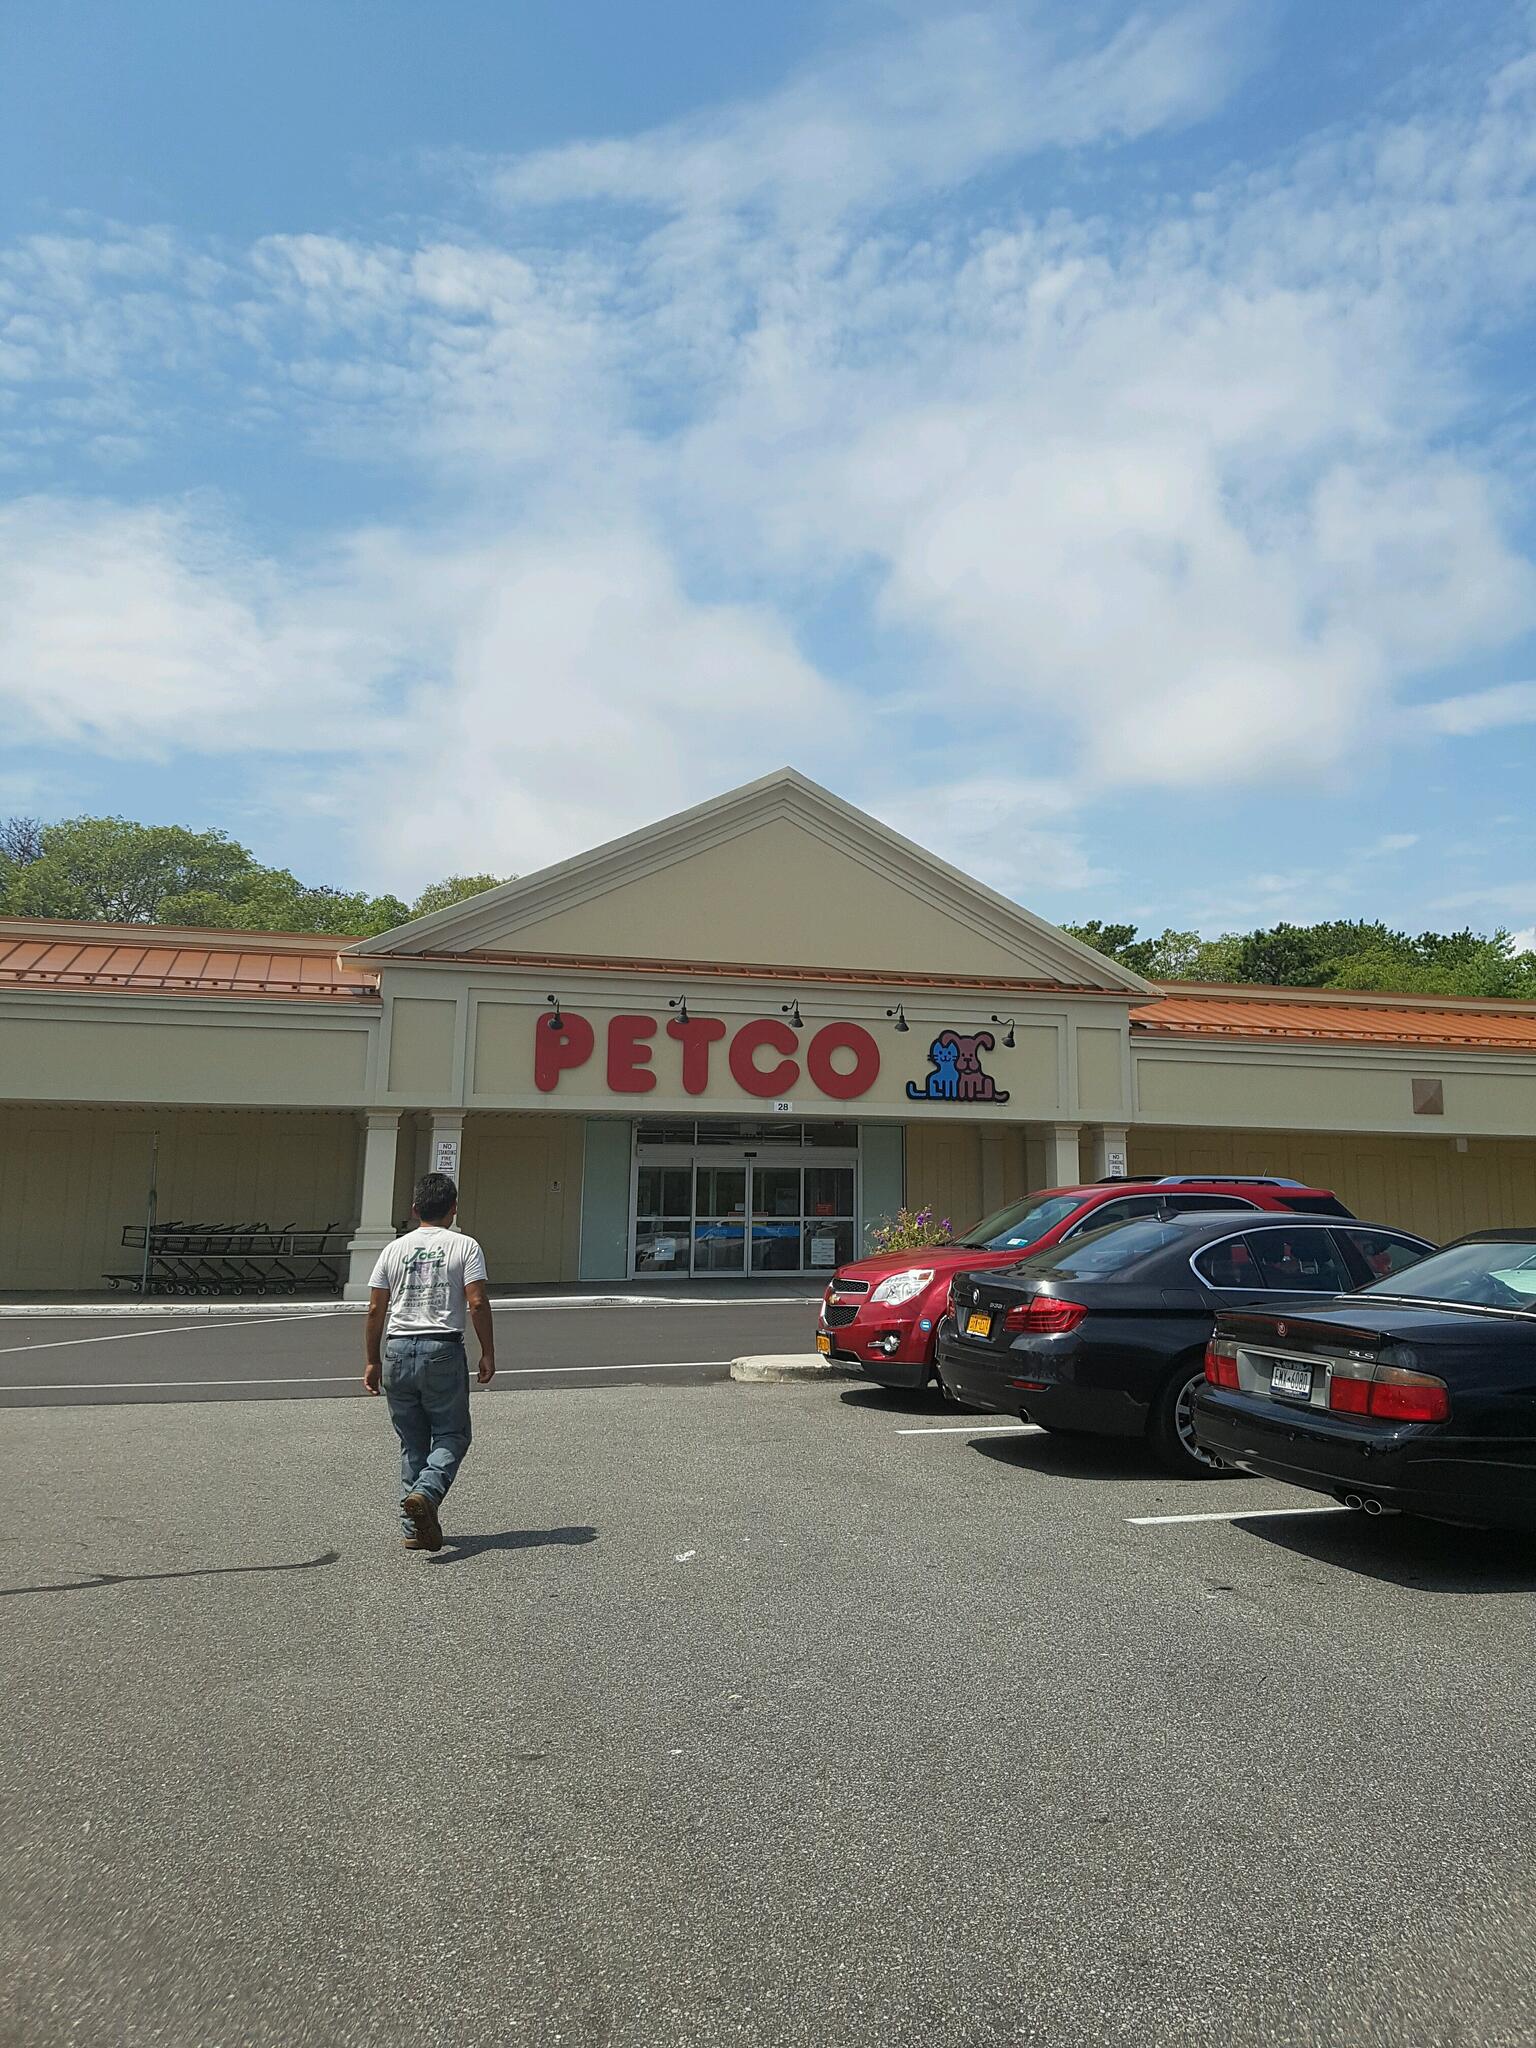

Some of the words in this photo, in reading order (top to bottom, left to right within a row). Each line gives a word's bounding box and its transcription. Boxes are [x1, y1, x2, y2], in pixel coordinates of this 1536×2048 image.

[534, 1012, 881, 1100] PETCO
[778, 1103, 789, 1111] 28
[402, 1246, 446, 1264] Joe's
[1348, 1350, 1374, 1360] SLS
